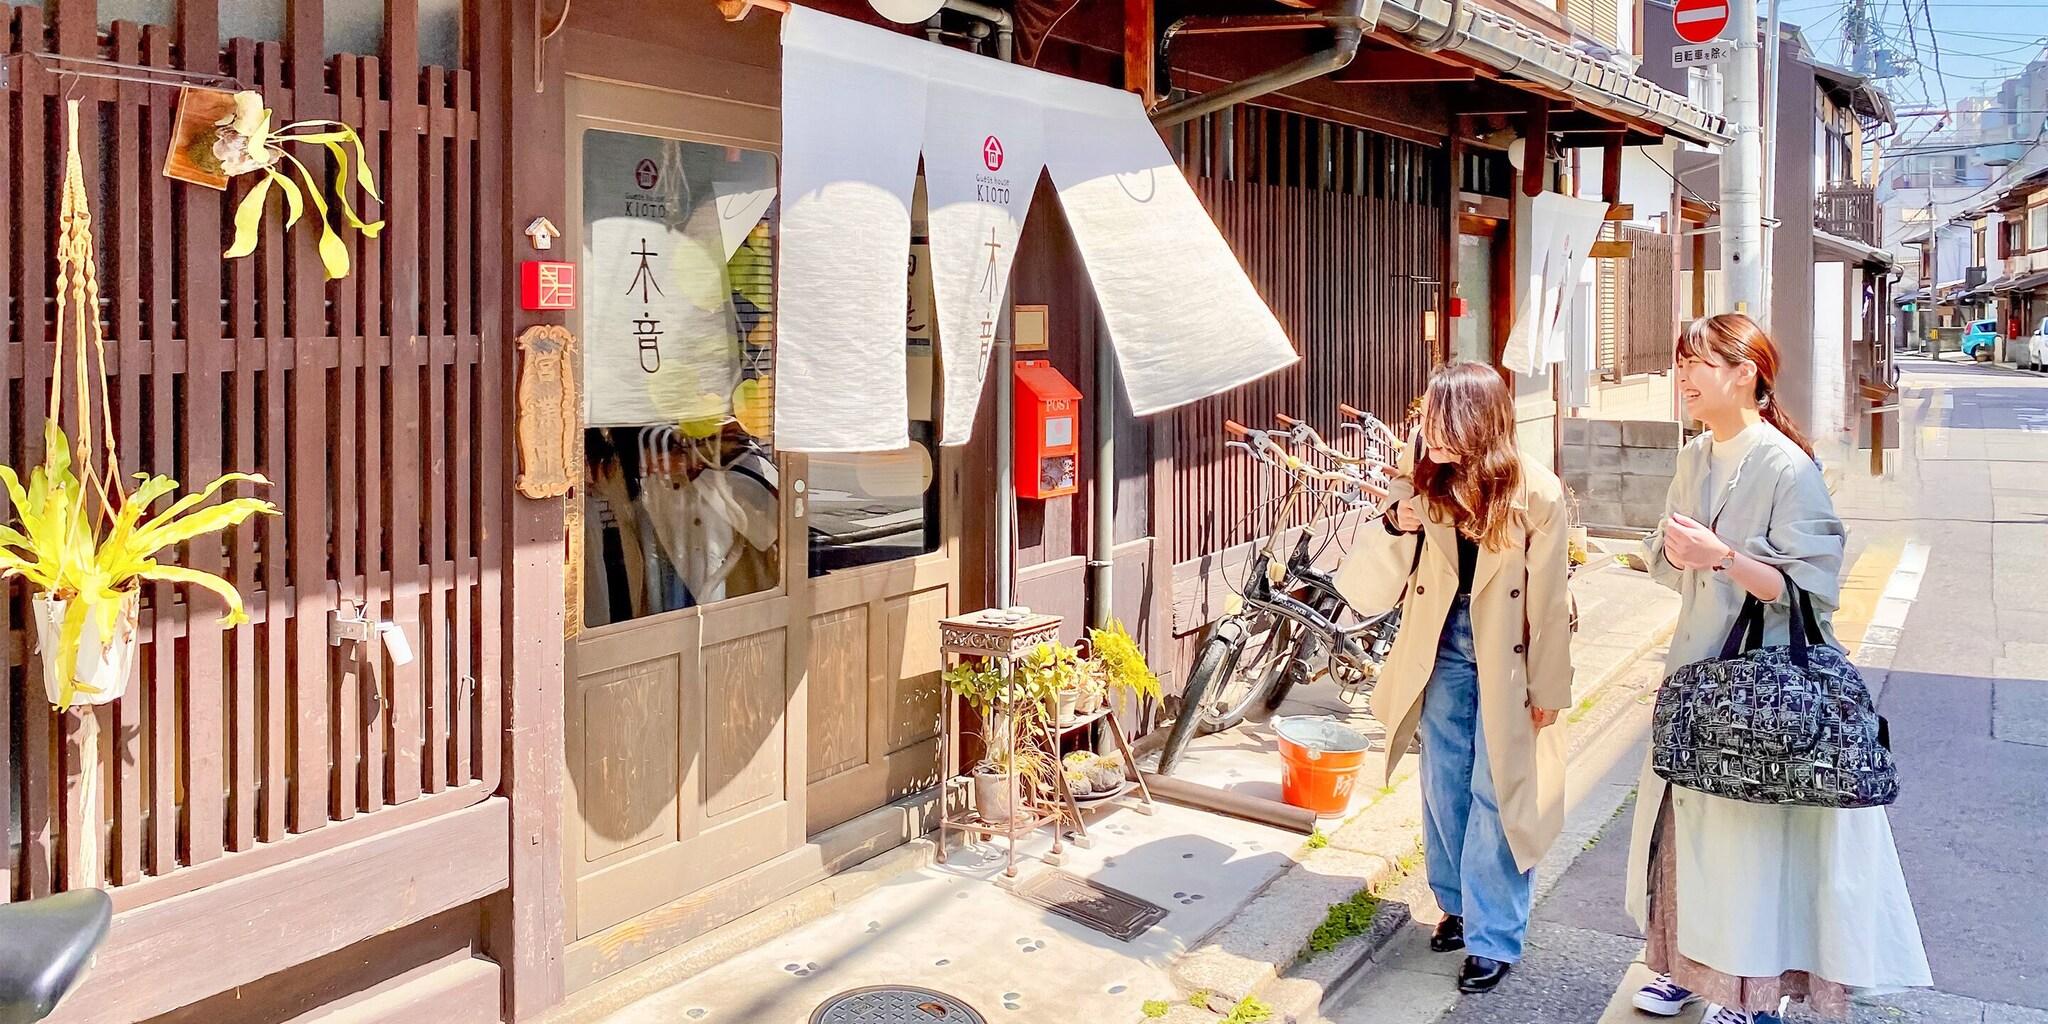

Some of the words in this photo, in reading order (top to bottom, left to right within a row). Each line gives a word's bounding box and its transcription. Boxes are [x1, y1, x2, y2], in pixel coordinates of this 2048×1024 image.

[1675, 47, 1727, 62] 自転車を除く
[977, 185, 1010, 204] KIOTO
[624, 201, 666, 218] KIOTO
[625, 238, 665, 374] 木音
[977, 227, 1001, 383] 木音
[1045, 400, 1071, 412] POST
[1333, 775, 1354, 798] 防
